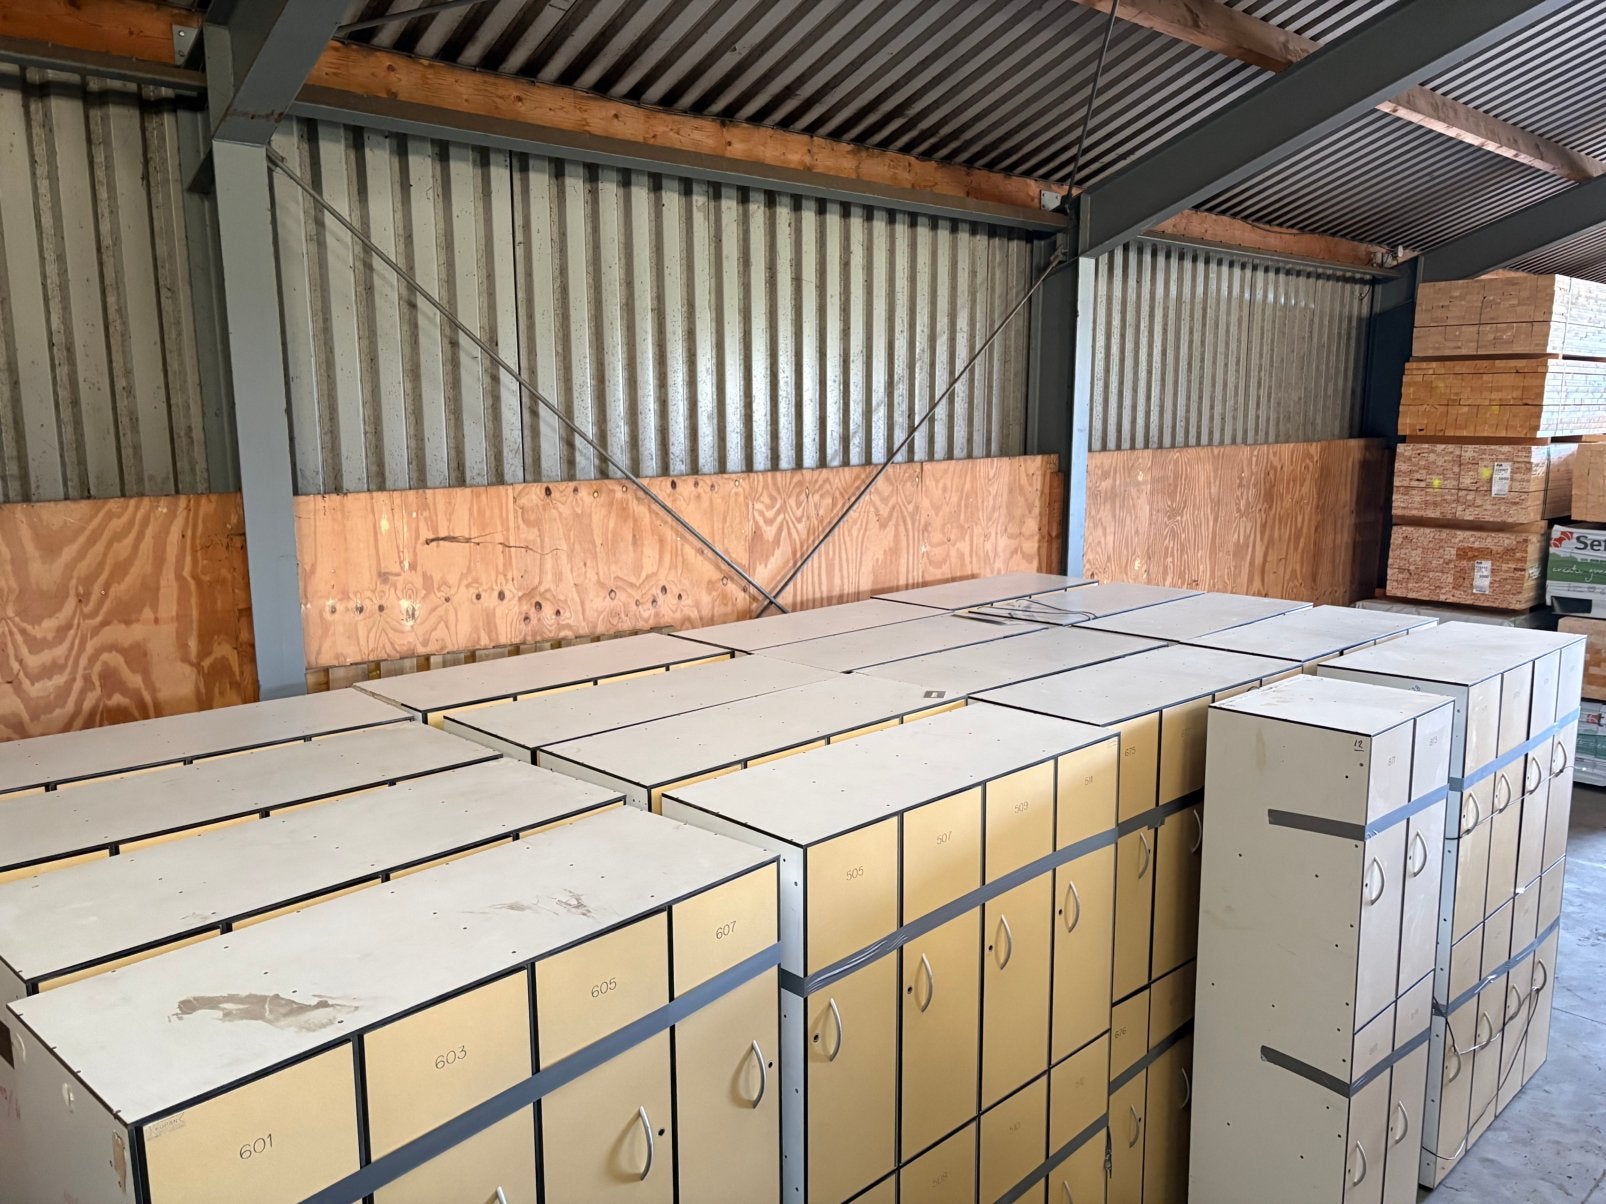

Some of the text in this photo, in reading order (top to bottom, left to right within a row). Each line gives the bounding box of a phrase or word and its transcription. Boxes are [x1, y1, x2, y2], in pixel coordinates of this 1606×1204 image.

[1014, 801, 1029, 814] 509
[936, 830, 952, 845] 507
[846, 865, 864, 882] 505
[715, 920, 737, 940] 607
[590, 977, 617, 998] 605
[434, 1045, 467, 1070] 603
[239, 1133, 274, 1160] 601
